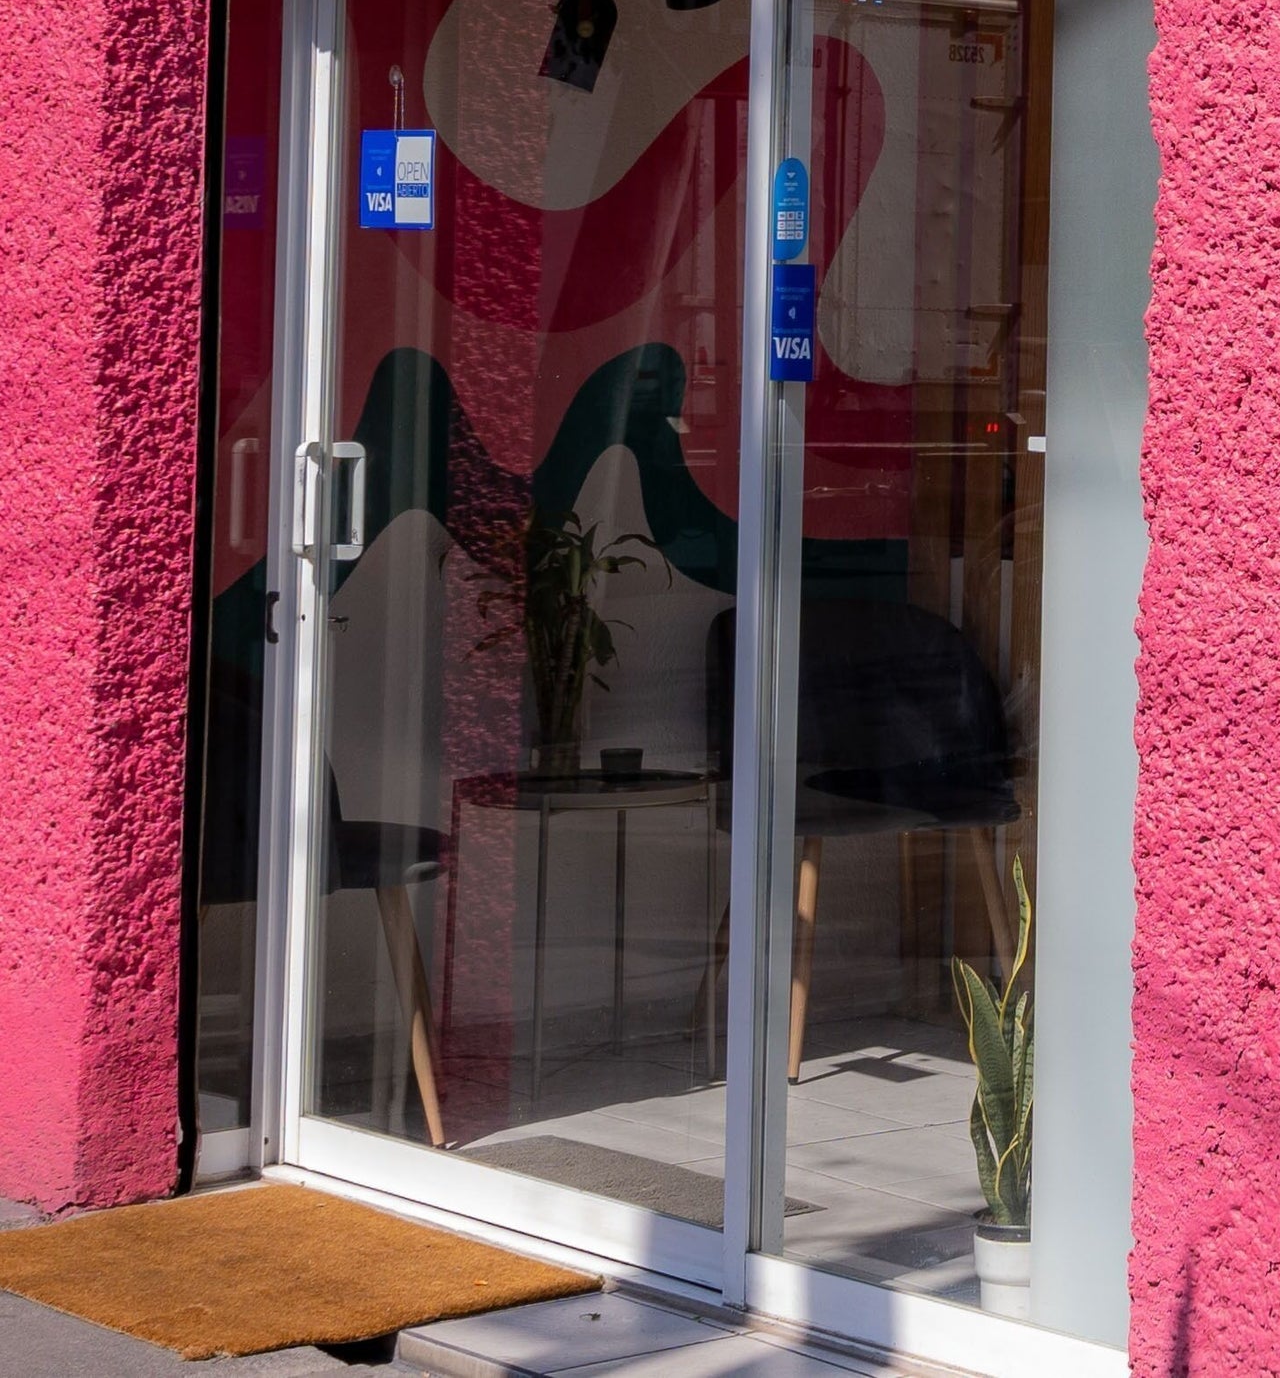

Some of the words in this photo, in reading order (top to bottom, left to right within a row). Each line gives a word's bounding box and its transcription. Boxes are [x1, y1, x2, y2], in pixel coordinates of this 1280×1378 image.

[397, 161, 429, 181] OPEN
[366, 192, 393, 212] VISA
[772, 336, 811, 360] VISA
